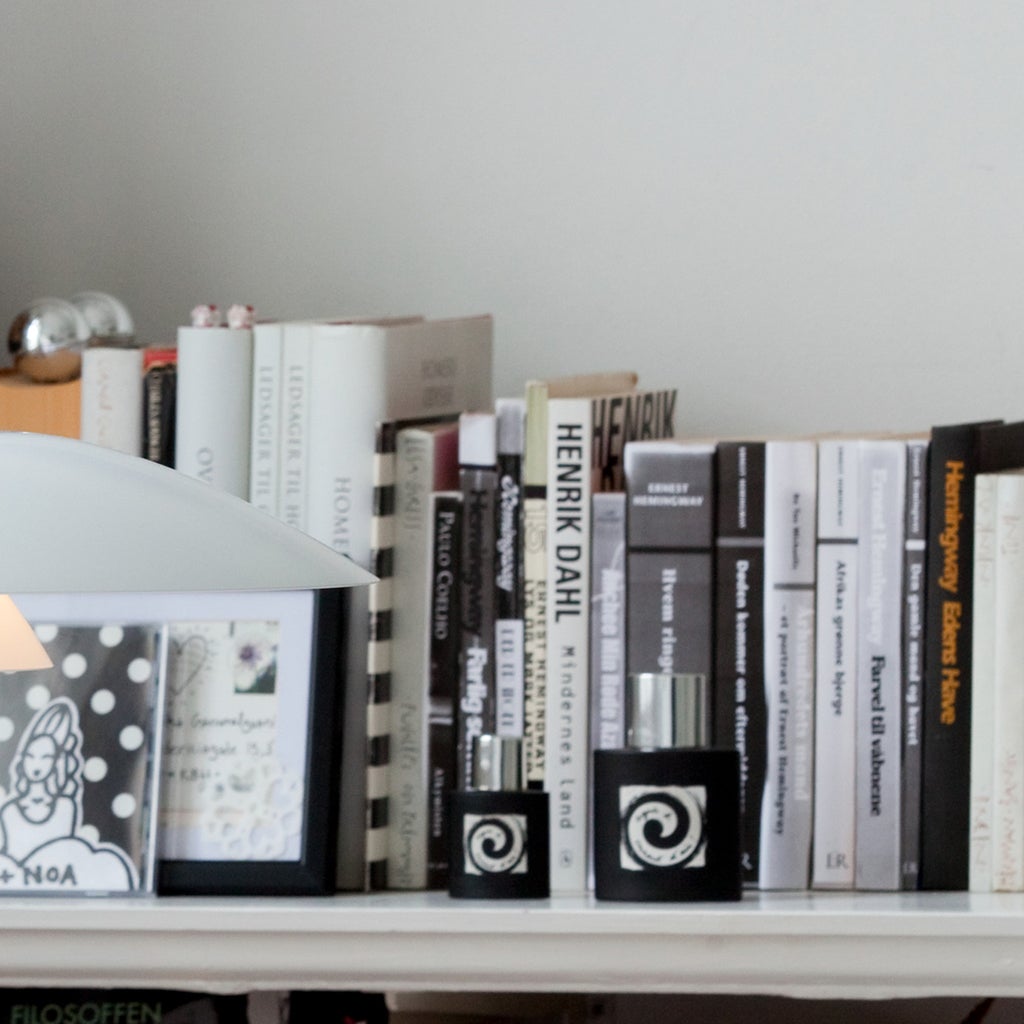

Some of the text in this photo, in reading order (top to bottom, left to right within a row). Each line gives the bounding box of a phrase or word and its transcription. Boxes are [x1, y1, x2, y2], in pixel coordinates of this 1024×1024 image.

[256, 366, 274, 497] LEDSAGER TIL
[285, 364, 304, 461] LEDSAGER
[285, 468, 302, 497] TIL
[332, 477, 353, 549] HOME
[555, 423, 583, 622] HENRIK DAHL
[435, 511, 456, 640] PAULO COELHO
[656, 567, 678, 674] Hvem ringe
[834, 561, 848, 611] Afrikas
[936, 460, 966, 725] Hemingway Edens Have
[460, 647, 489, 714] Farlig
[534, 579, 548, 770] ERNEST HEMINGWAY
[560, 647, 578, 830] Mindernes land
[869, 656, 888, 817] Farvel til våbnene
[23, 864, 78, 886] NOA
